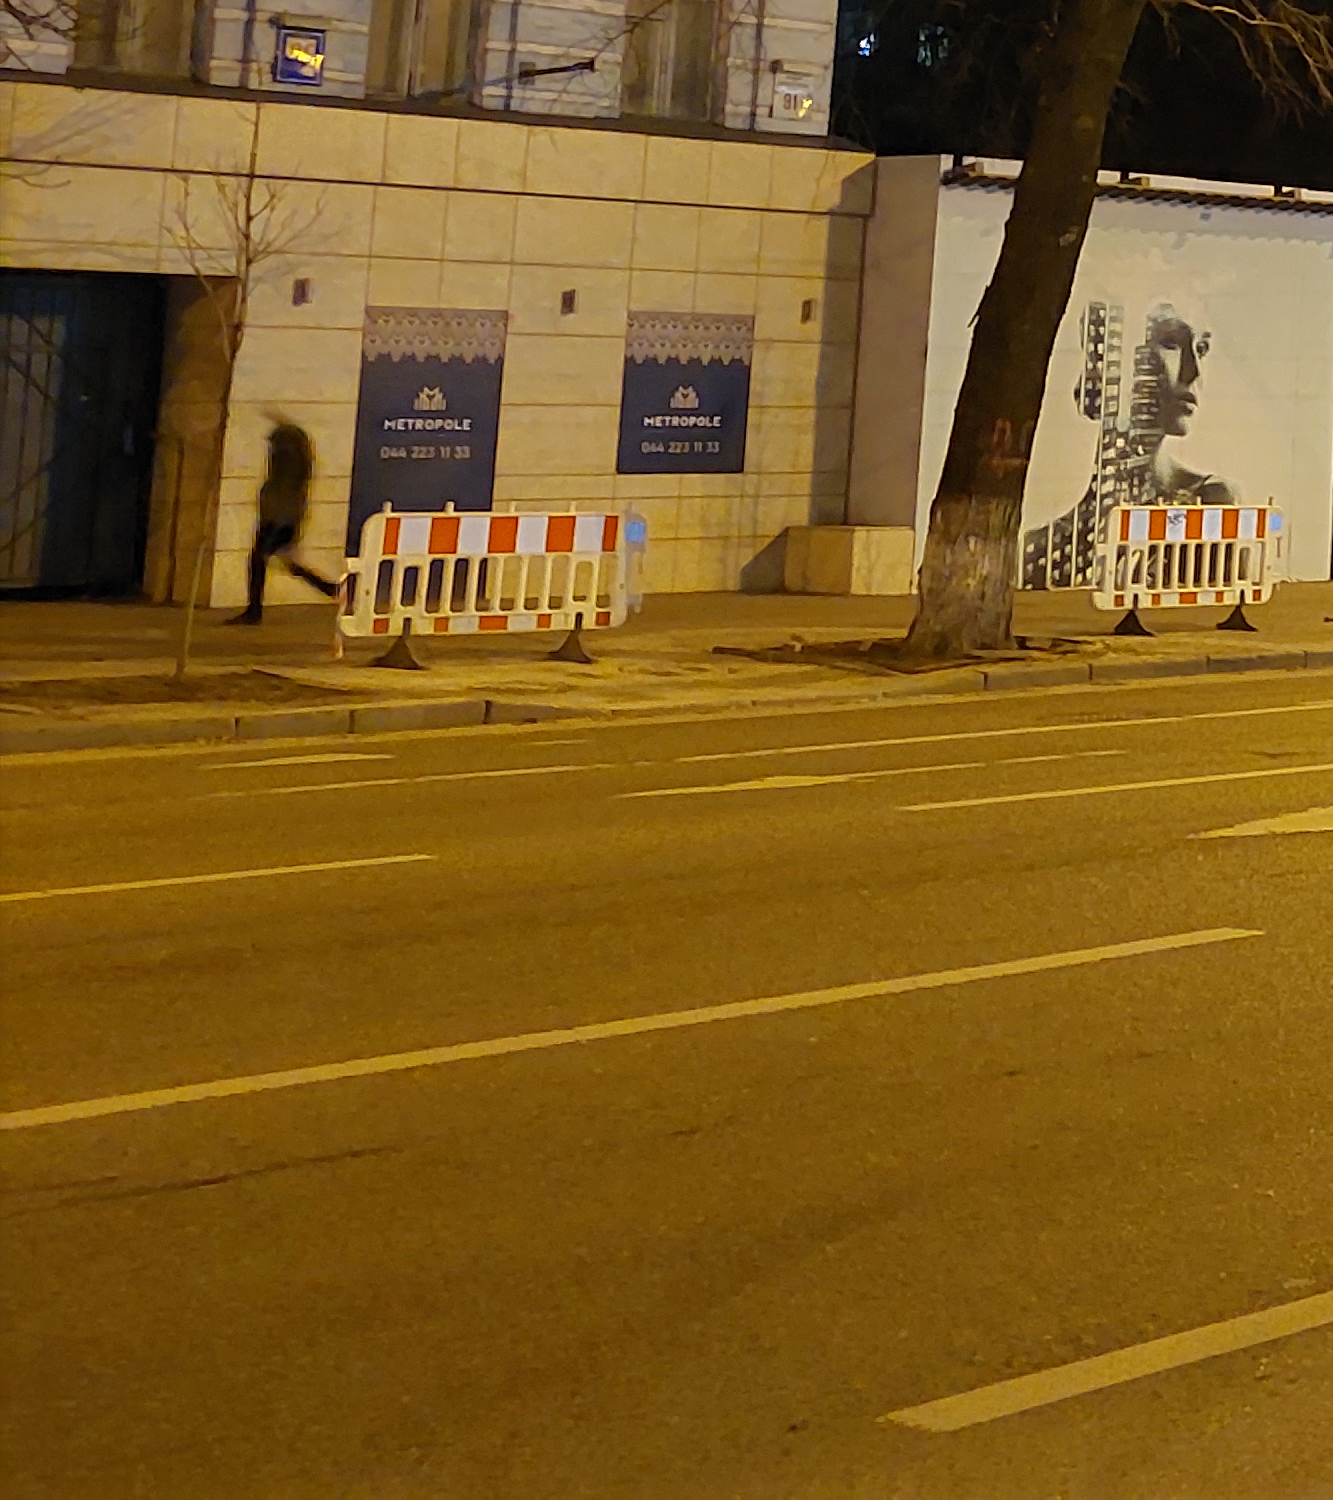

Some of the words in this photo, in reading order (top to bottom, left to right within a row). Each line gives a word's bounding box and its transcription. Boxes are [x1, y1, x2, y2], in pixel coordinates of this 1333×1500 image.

[383, 418, 473, 431] METROPOLE
[643, 415, 722, 428] METROPOLE
[380, 445, 407, 459] 044
[410, 445, 436, 459] 223
[440, 445, 451, 459] 11
[454, 445, 471, 459] 33
[641, 441, 665, 454] 044
[667, 441, 690, 453] 223
